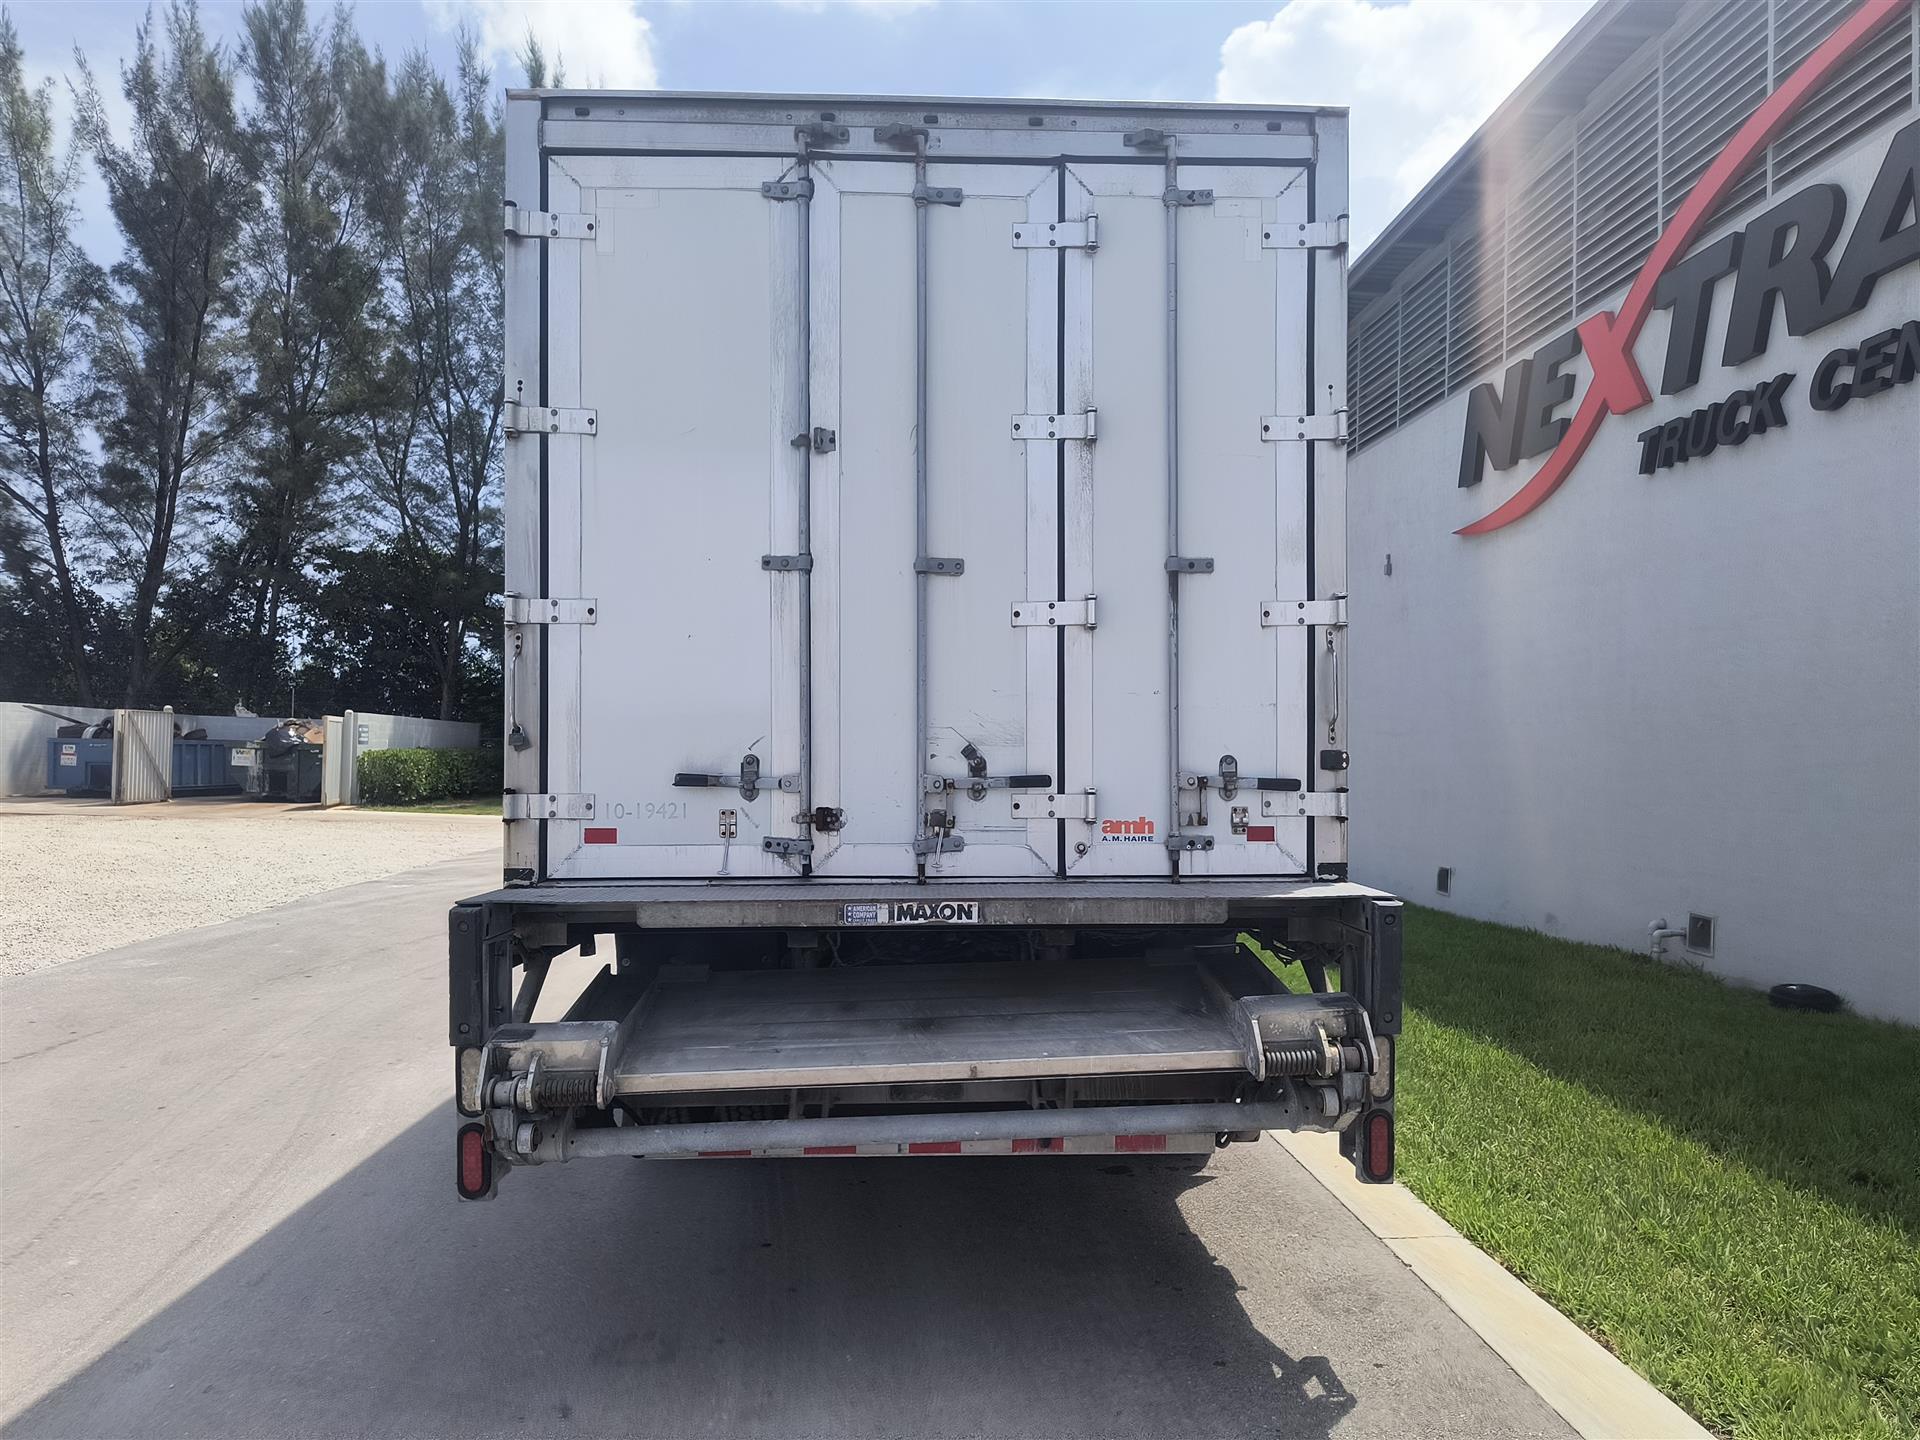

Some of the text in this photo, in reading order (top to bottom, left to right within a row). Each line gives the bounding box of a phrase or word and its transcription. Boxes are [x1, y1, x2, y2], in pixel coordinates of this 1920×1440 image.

[1637, 372, 1797, 475] TRUCK
[605, 802, 688, 819] 10-19421
[1102, 817, 1154, 834] amh
[896, 904, 973, 921] MAXON
